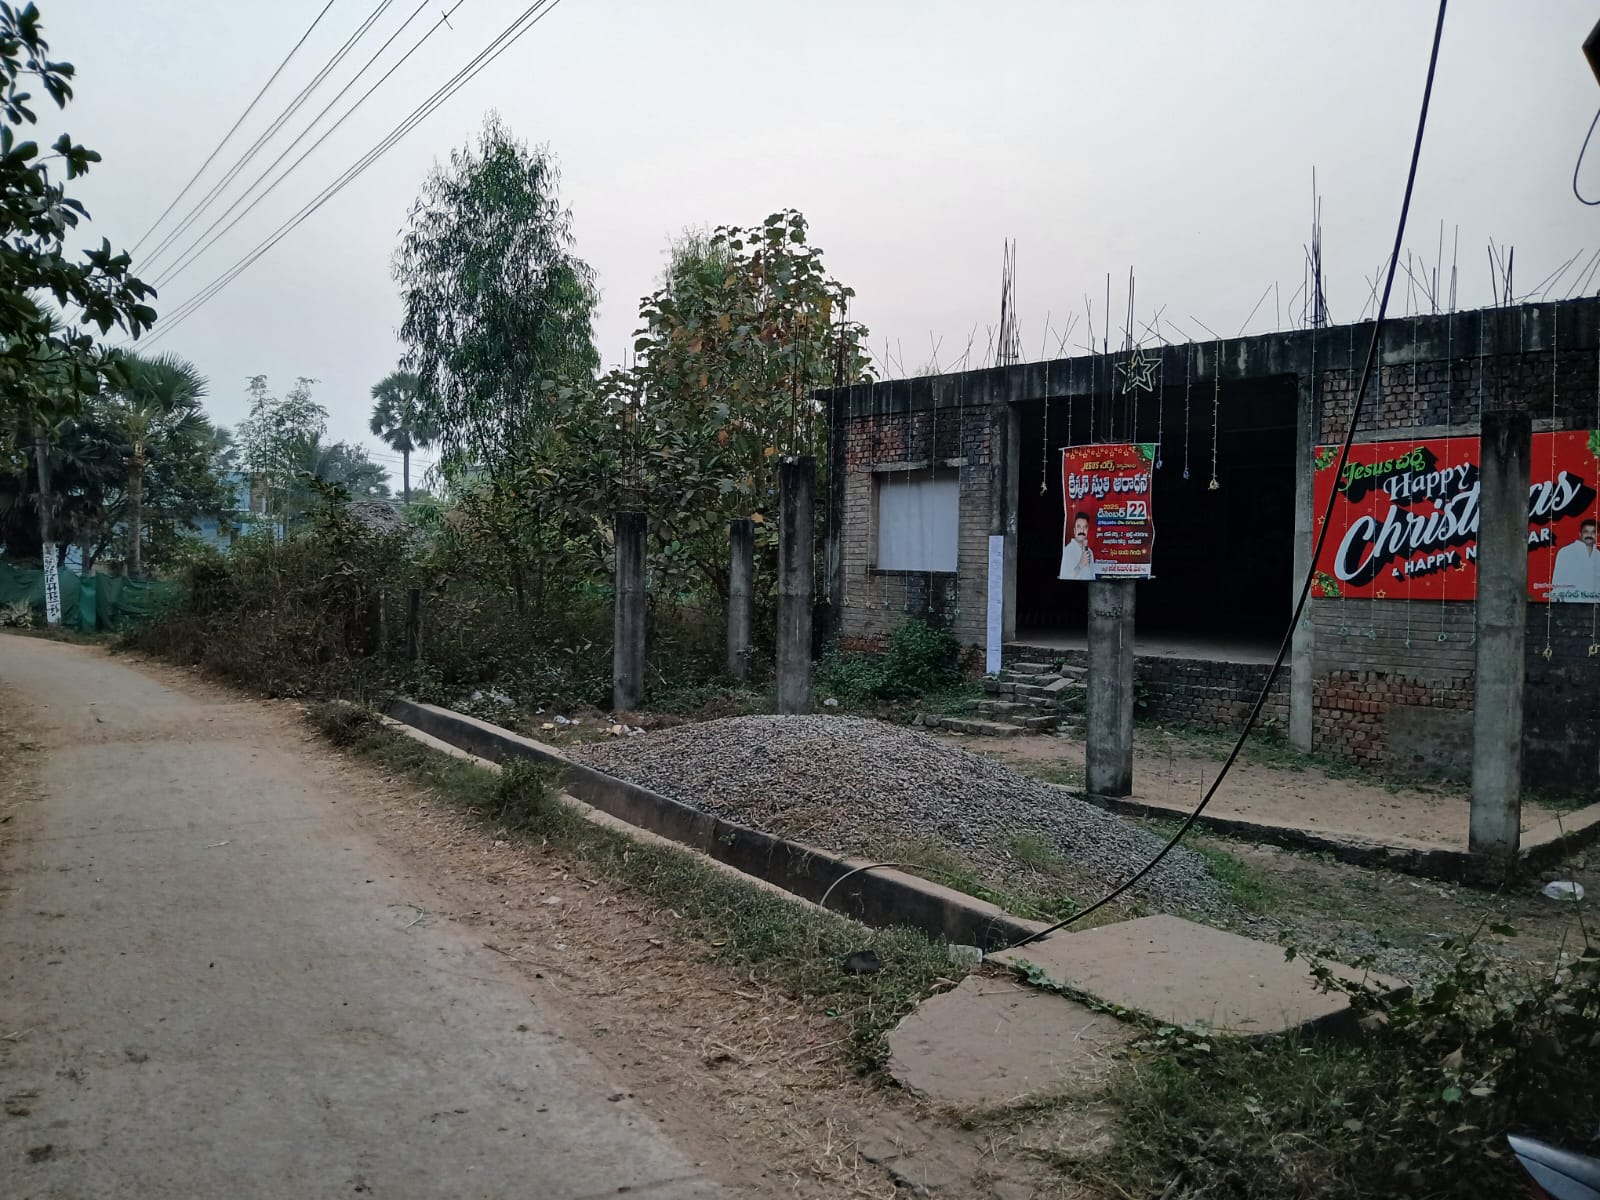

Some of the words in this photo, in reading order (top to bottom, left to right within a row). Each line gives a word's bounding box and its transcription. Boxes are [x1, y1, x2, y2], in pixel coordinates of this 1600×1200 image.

[1338, 458, 1394, 492] Jesus
[1383, 462, 1470, 502] Happy
[1129, 503, 1146, 518] 22
[1334, 471, 1582, 581] Christas
[1392, 568, 1399, 577] &
[1405, 550, 1456, 574] HAPPY
[1527, 528, 1550, 545] AR
